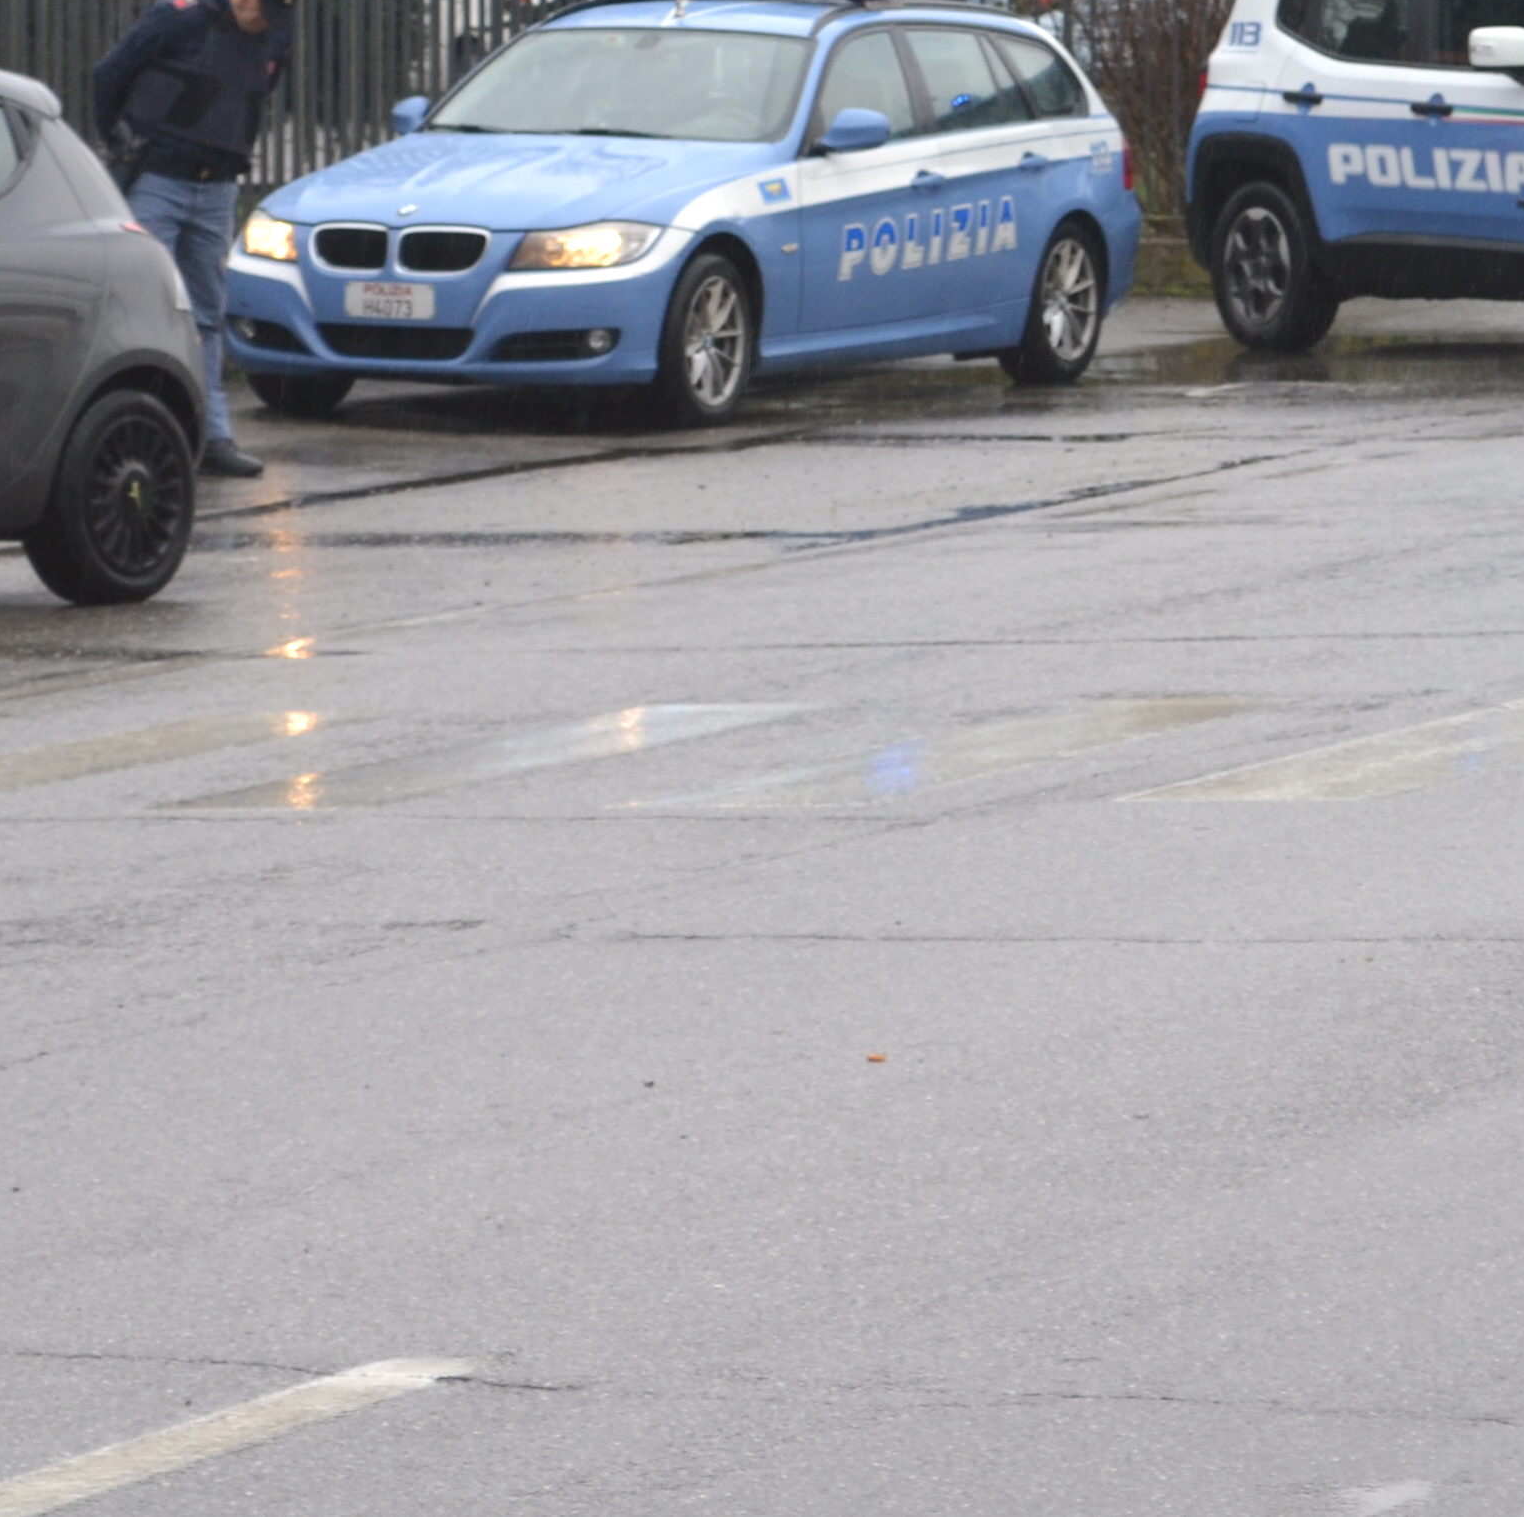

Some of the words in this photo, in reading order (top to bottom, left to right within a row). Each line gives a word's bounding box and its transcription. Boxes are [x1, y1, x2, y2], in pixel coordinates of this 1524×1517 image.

[1229, 22, 1262, 47] 113
[837, 194, 1018, 282] POLIZIA
[364, 283, 413, 297] POLIZIA
